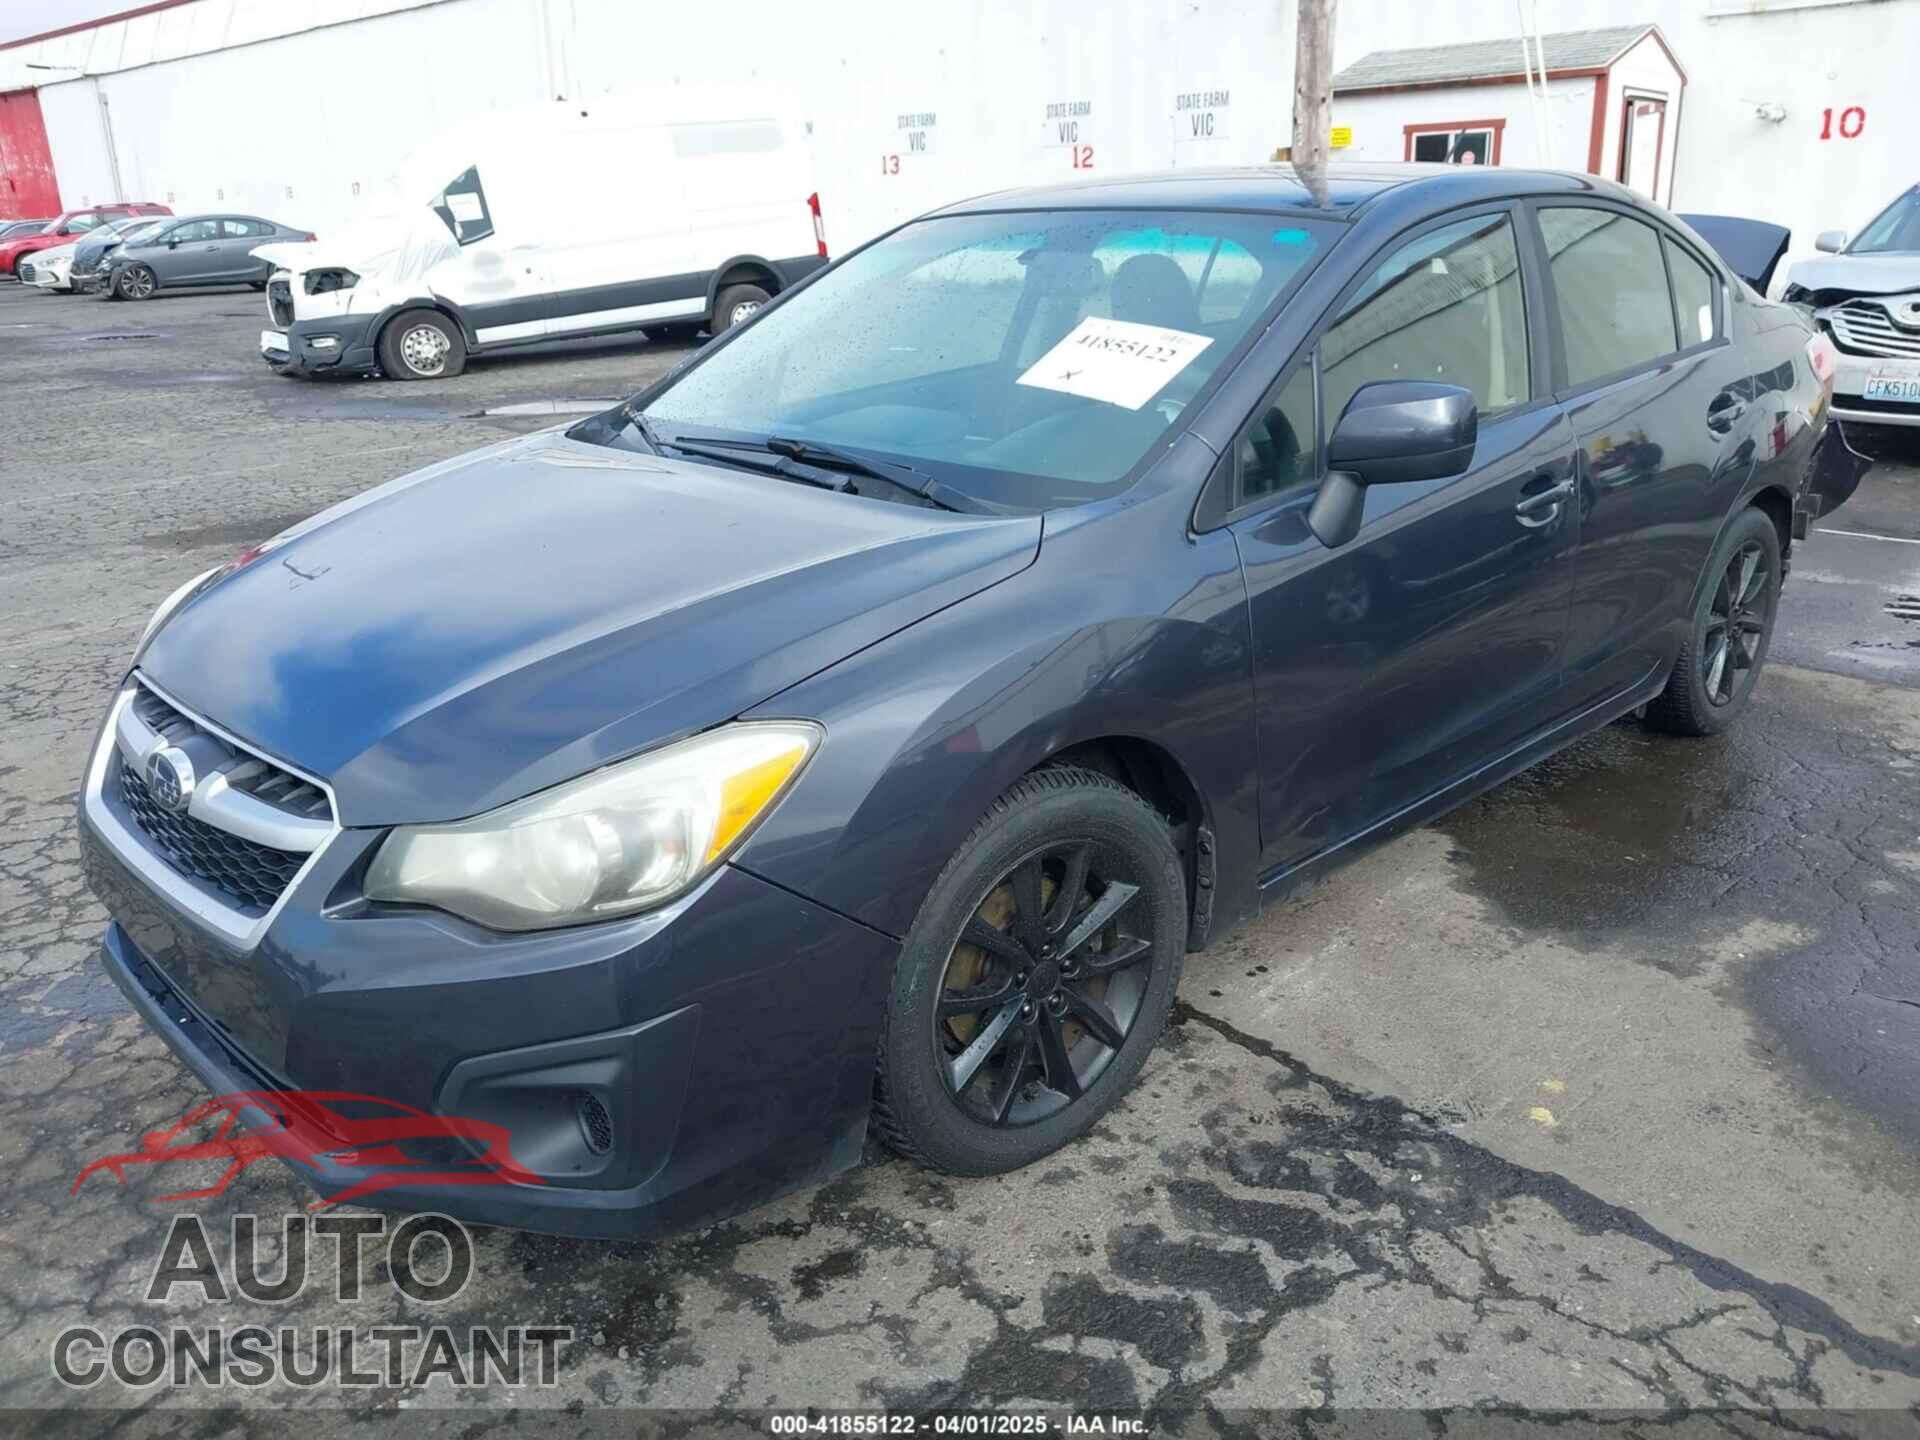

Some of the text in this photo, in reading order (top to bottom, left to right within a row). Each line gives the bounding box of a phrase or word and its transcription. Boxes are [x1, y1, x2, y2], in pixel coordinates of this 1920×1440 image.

[1047, 101, 1091, 120] STATE FARM
[1177, 90, 1230, 111] STATE FARM
[897, 112, 936, 129] STATE FARM
[1192, 112, 1214, 136] VIC
[1820, 107, 1865, 139] 10
[909, 131, 926, 151] VIC
[1059, 121, 1078, 144] VIC
[882, 155, 900, 175] 13
[1073, 146, 1094, 169] 12
[1867, 380, 1920, 397] CFK510
